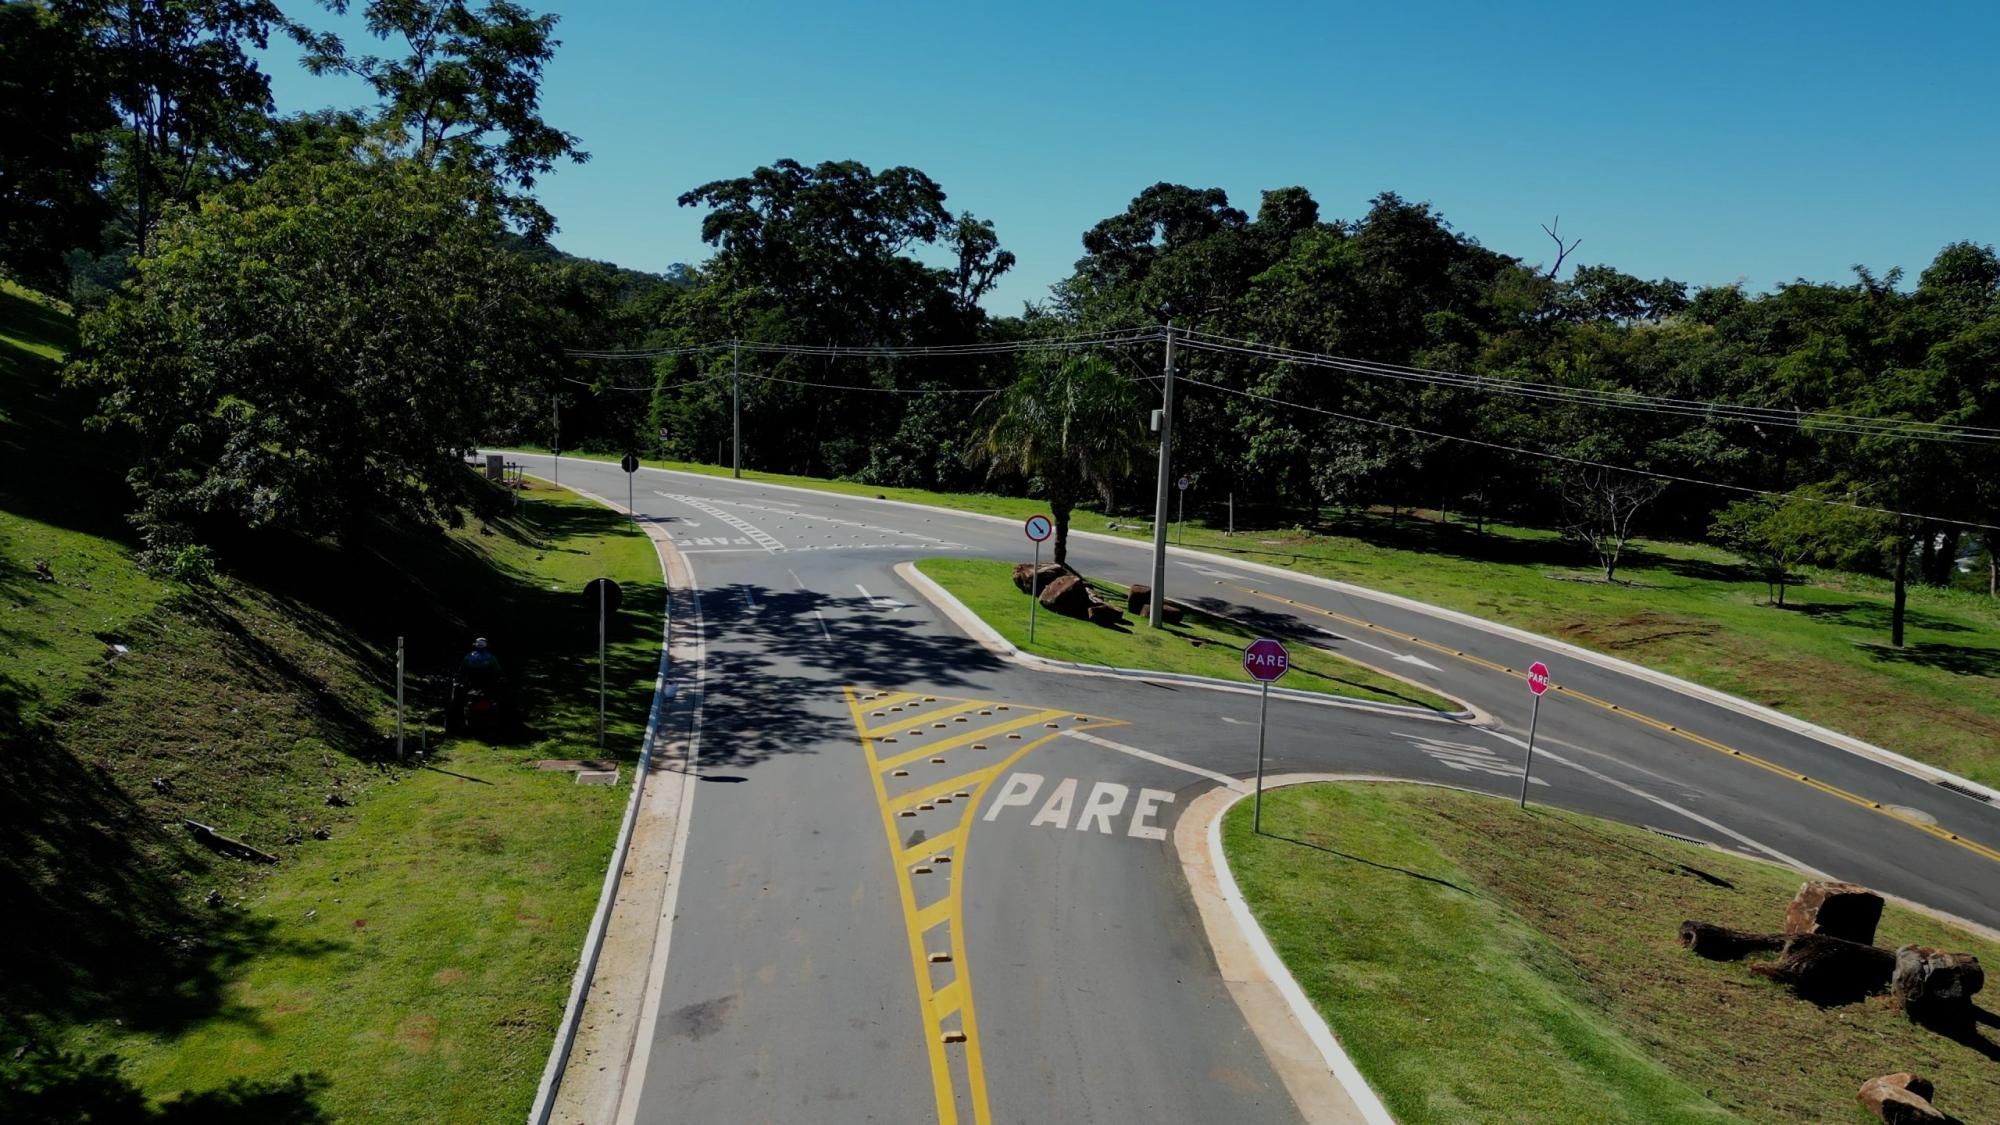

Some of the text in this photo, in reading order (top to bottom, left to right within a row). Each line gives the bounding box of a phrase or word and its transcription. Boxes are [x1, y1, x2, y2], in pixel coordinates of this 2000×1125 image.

[1247, 653, 1285, 667] PARE
[1529, 672, 1548, 686] PARE
[983, 772, 1176, 841] PARE
